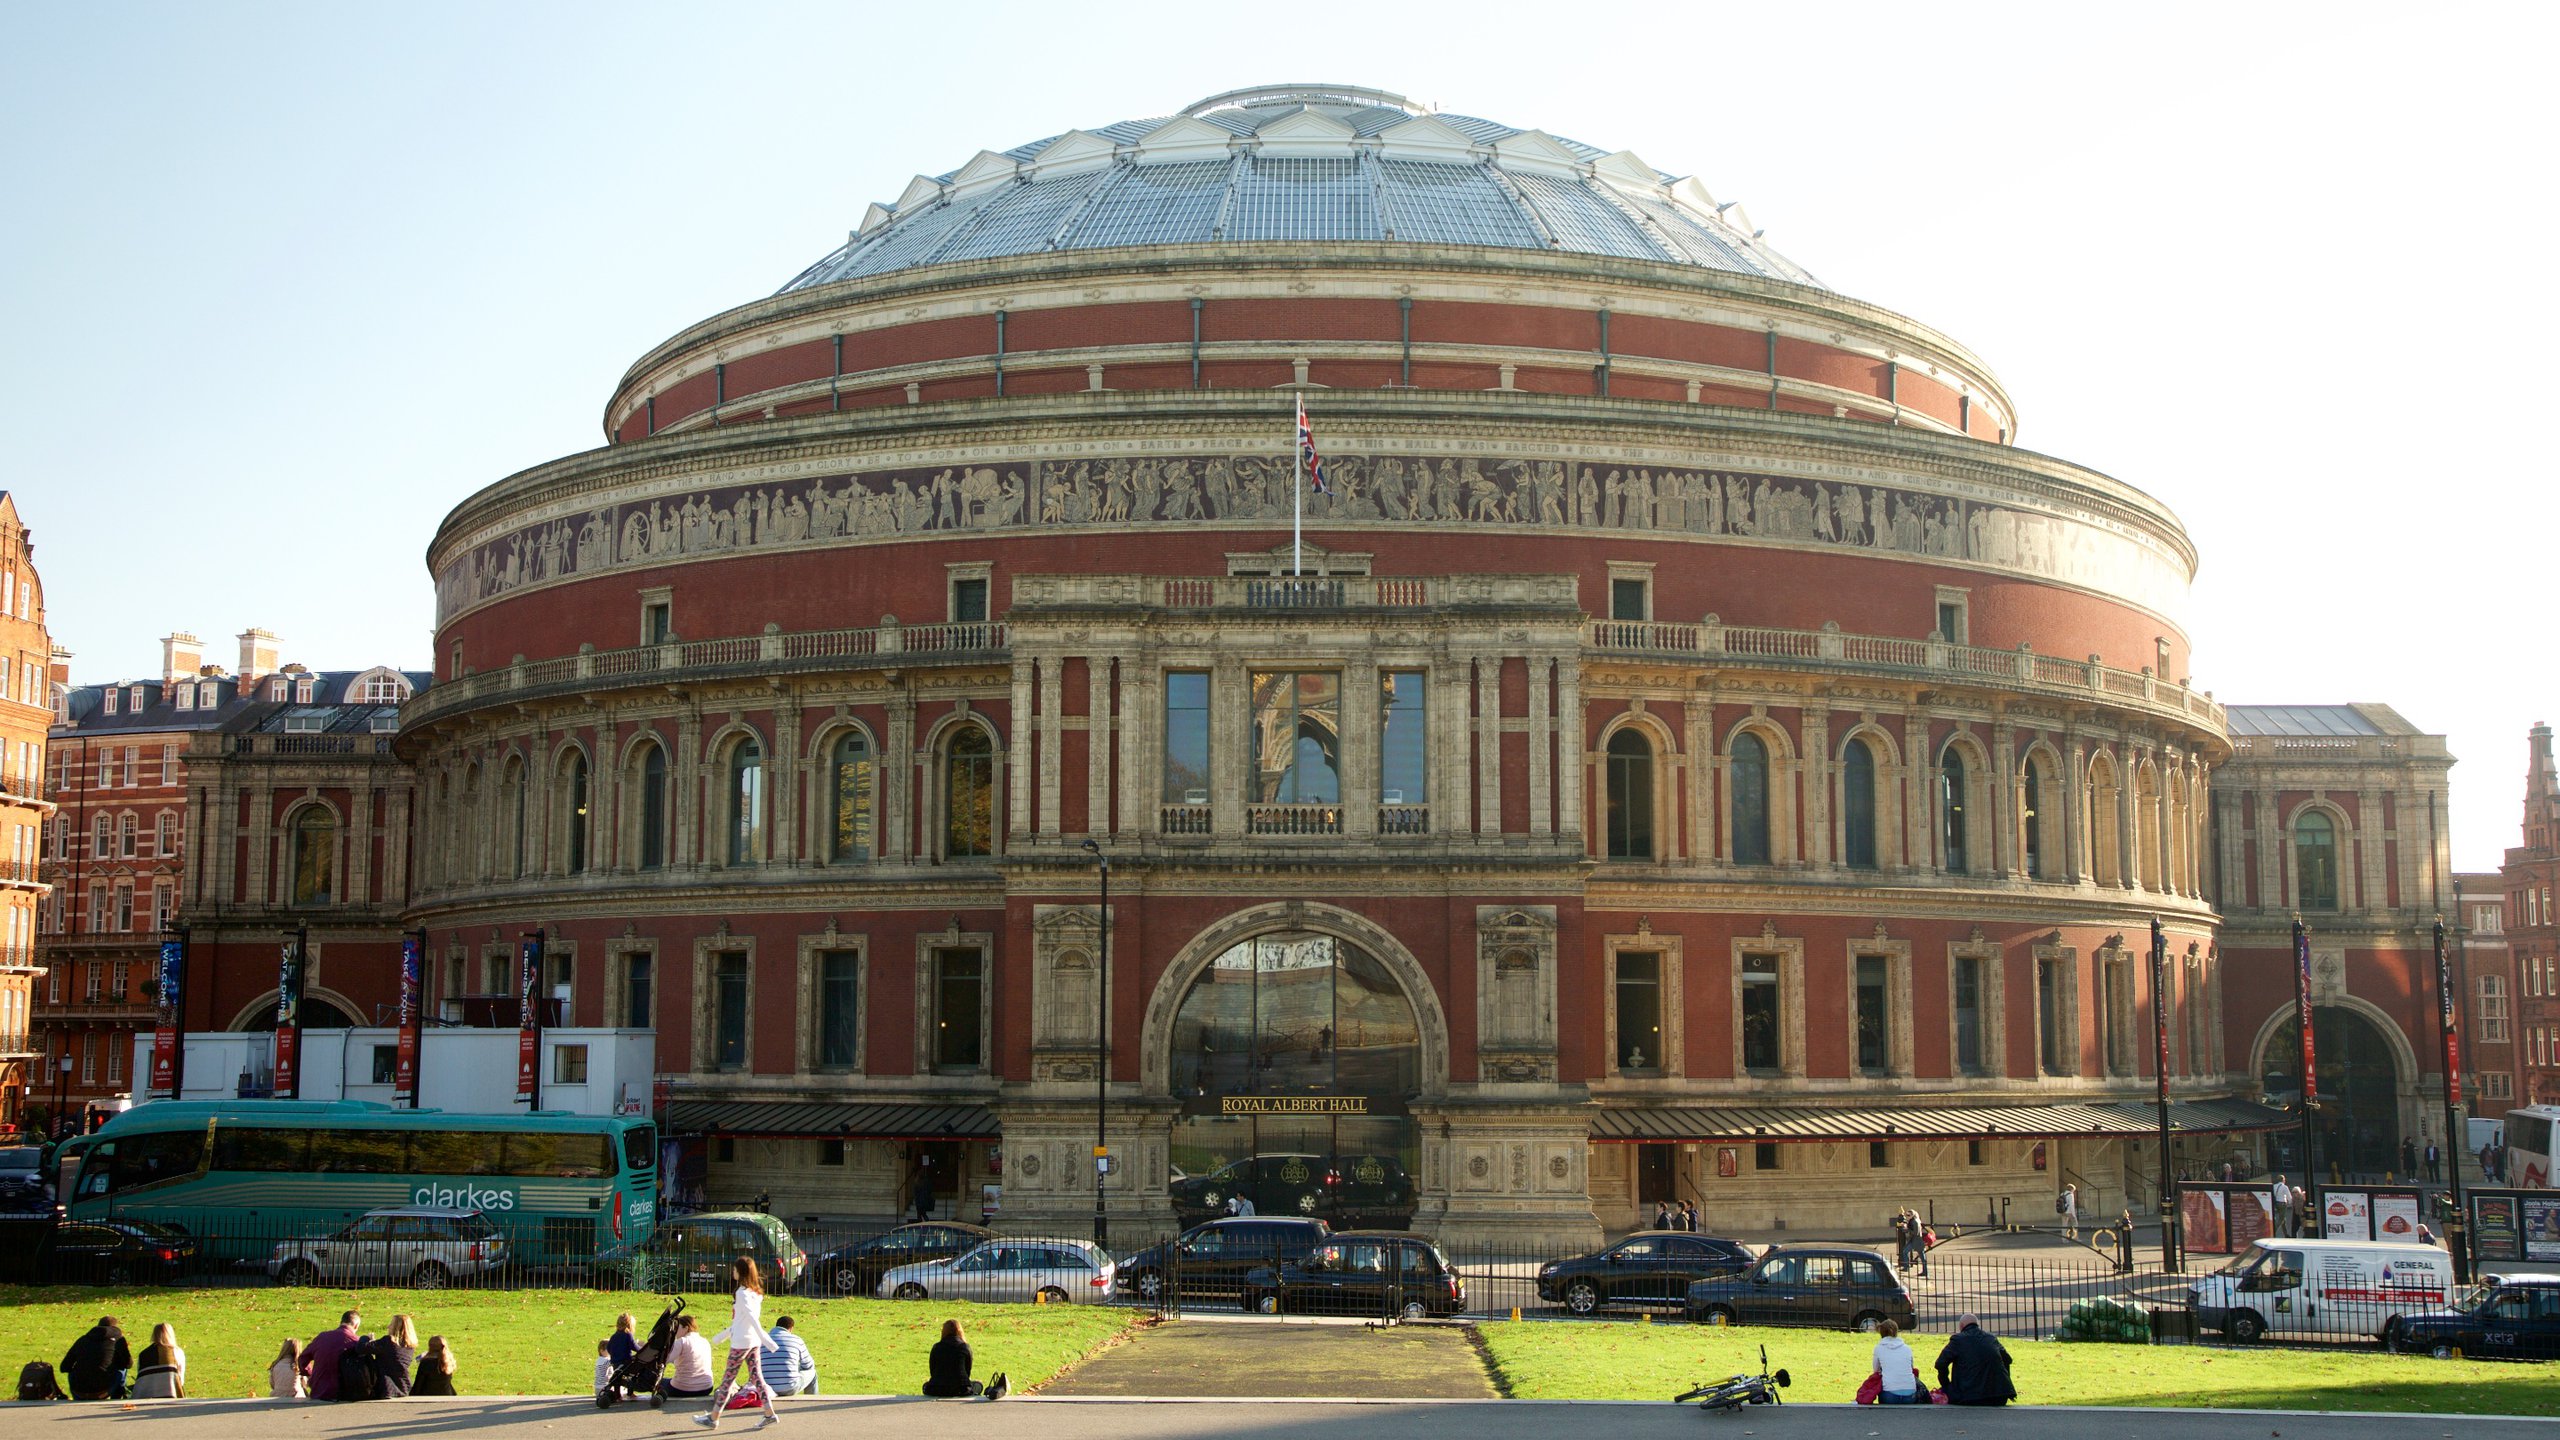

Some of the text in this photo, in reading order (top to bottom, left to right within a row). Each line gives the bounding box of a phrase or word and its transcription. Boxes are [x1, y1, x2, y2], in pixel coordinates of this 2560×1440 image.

[710, 471, 735, 483] HAND
[780, 463, 801, 474] GOD
[817, 457, 852, 470] GLORY
[930, 449, 954, 460] GOD
[1008, 444, 1037, 455] HIGH
[1057, 443, 1082, 453] AND
[1103, 441, 1120, 451] ON
[1141, 439, 1181, 450] EARTH
[1203, 439, 1243, 449] PEACE
[1357, 439, 1384, 448] THIS
[1405, 439, 1437, 449] HALL
[1505, 442, 1559, 453] ERECTED
[1622, 448, 1645, 458] THE
[1662, 450, 1745, 465] ADVANCEMENT
[282, 948, 290, 972] EAT
[402, 949, 410, 978] TAKE
[159, 948, 169, 1008] WELCOME
[277, 984, 288, 1023] DRINK
[400, 992, 409, 1025] TOUR
[1222, 1099, 1367, 1111] ROYAL ALBERT HALL
[415, 1182, 514, 1210] clarkes
[629, 1199, 653, 1217] clarkes
[2393, 1261, 2435, 1270] GENERAL
